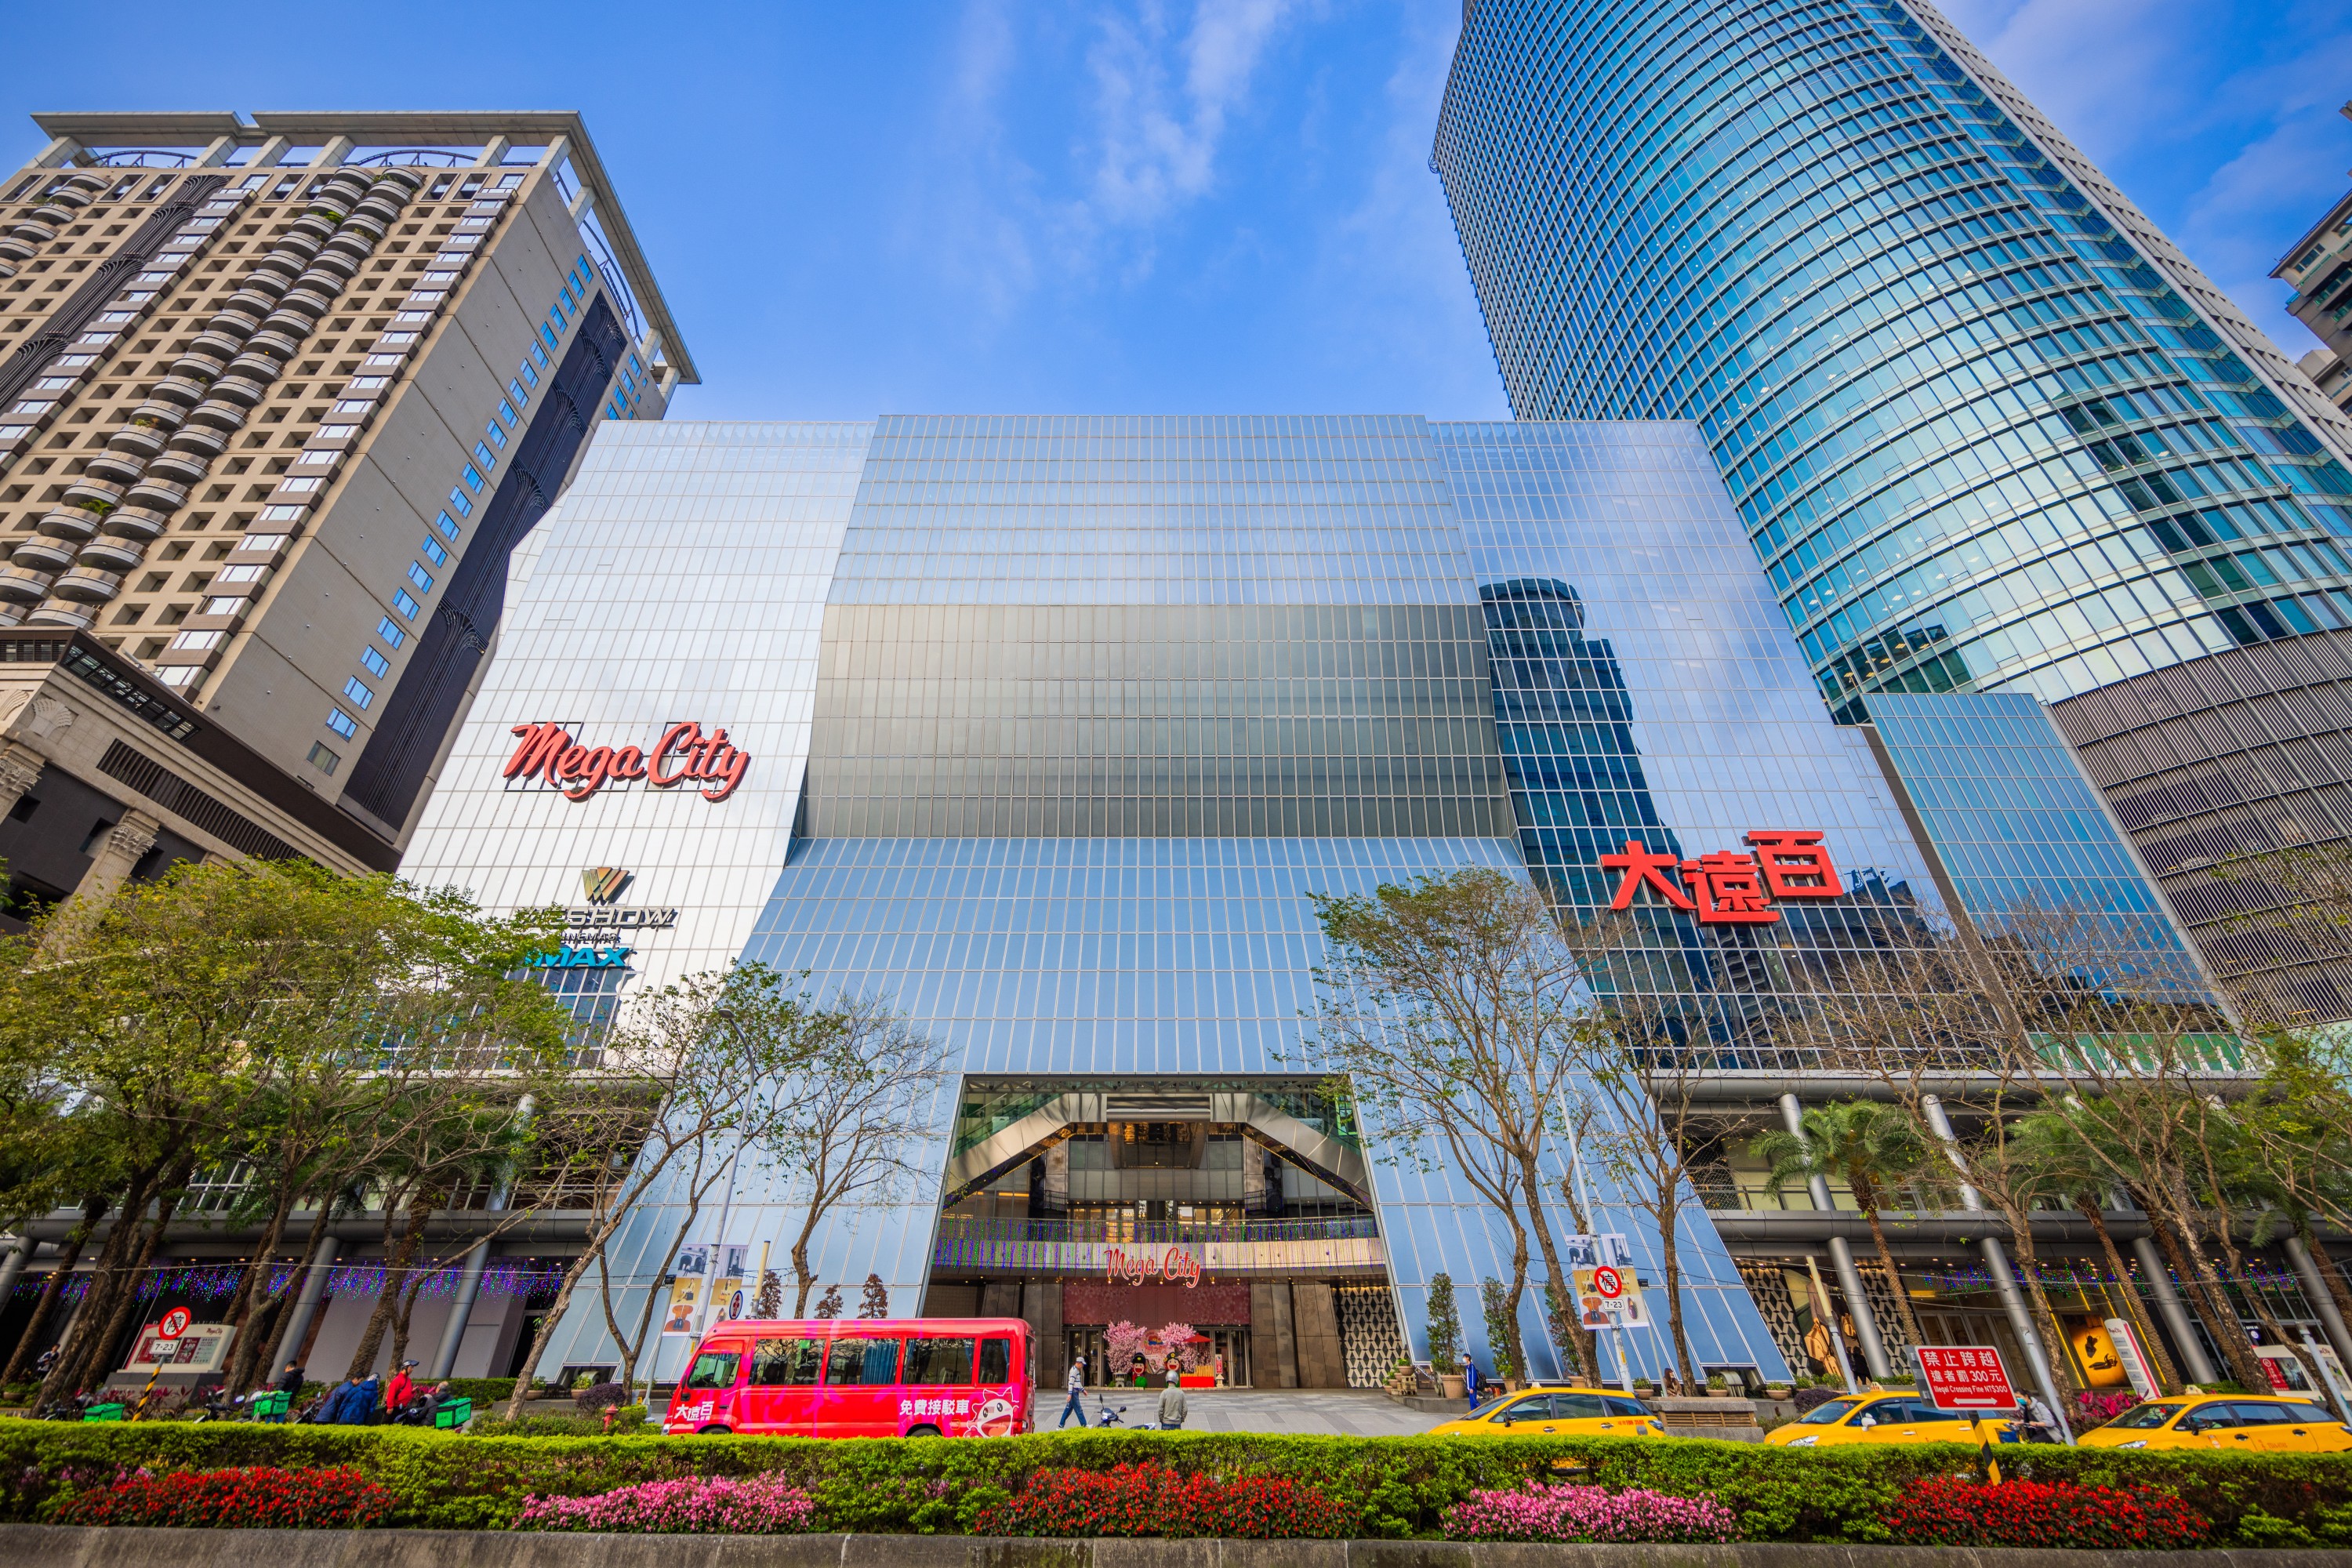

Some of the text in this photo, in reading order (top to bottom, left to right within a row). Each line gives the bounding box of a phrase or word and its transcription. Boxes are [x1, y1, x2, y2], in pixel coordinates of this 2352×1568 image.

[503, 721, 750, 800] Mega City
[1600, 830, 1844, 923] 大遠百
[558, 932, 618, 941] INEMAS
[1104, 1247, 1200, 1288] Mega City
[1601, 1273, 1616, 1291] 停
[165, 1314, 185, 1333] 停
[1923, 1351, 1996, 1367] 禁止跨越
[1933, 1385, 1949, 1394] Illegal
[1949, 1385, 1973, 1394] Crossing
[1985, 1385, 2008, 1393] NT$300
[674, 1400, 715, 1421] 大遠百
[899, 1399, 970, 1416] 免費接駁車
